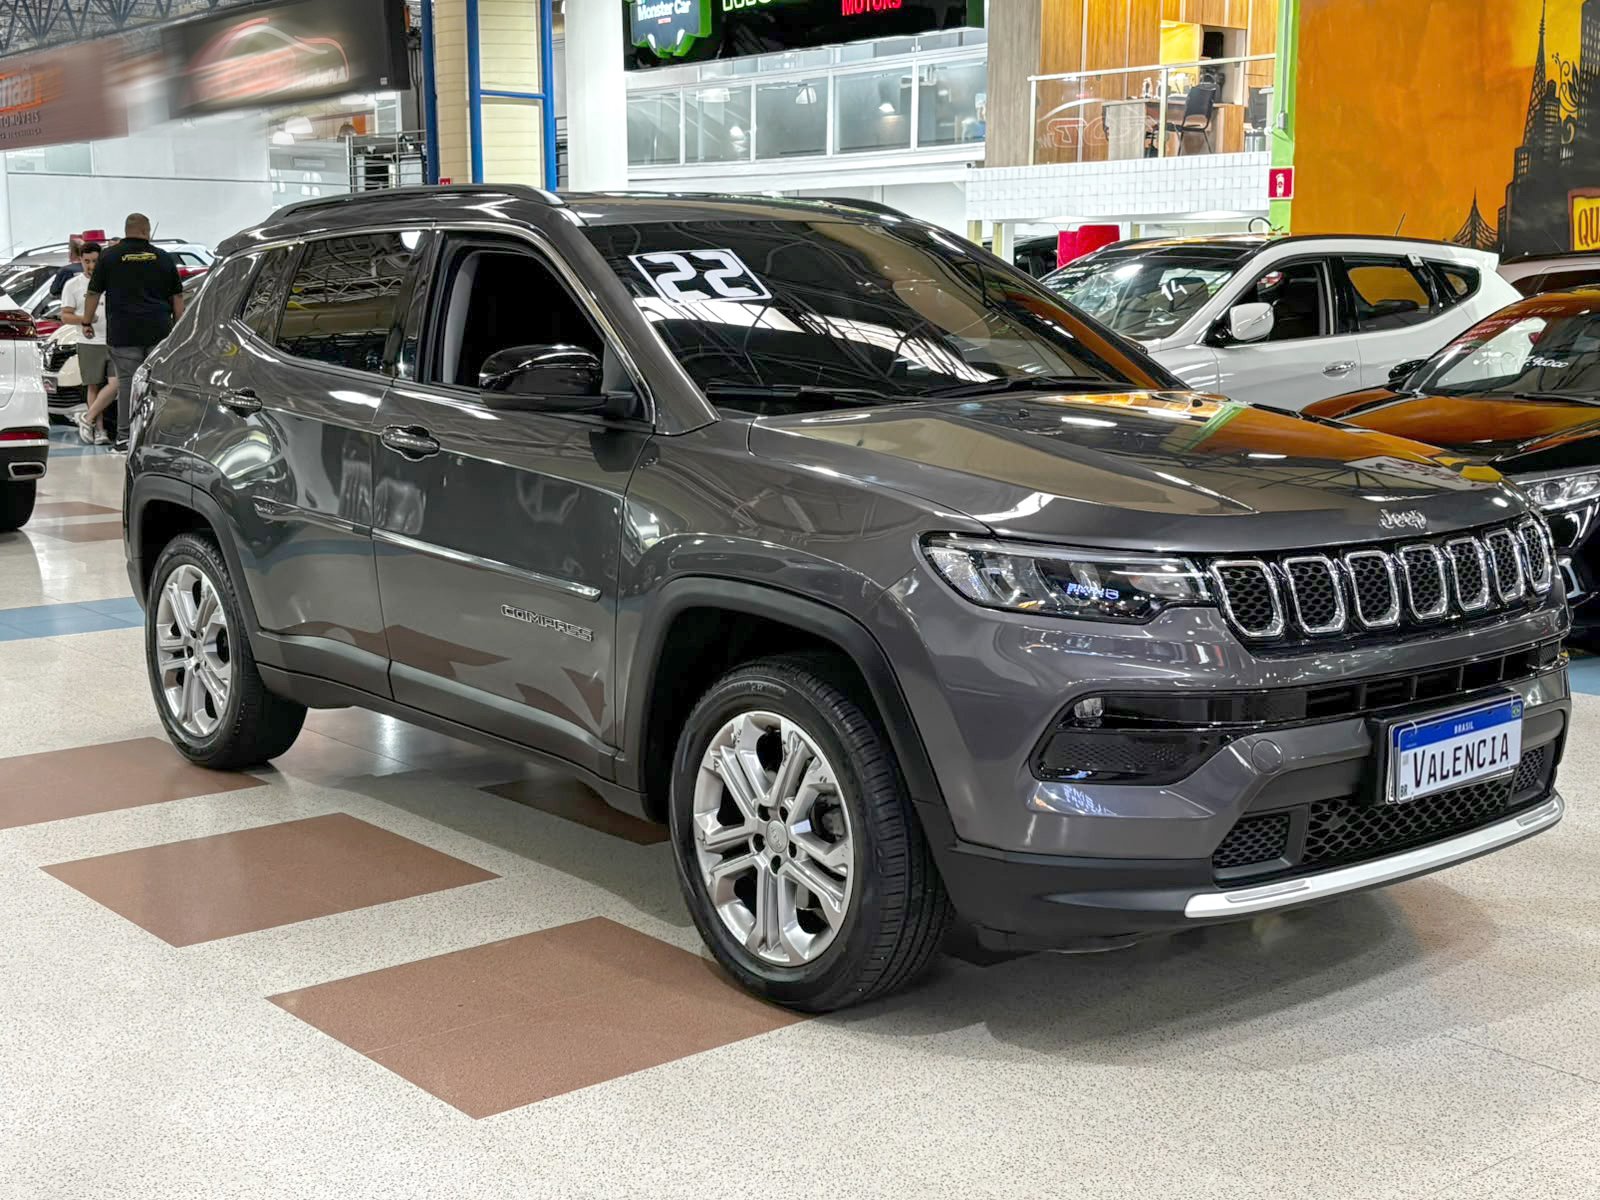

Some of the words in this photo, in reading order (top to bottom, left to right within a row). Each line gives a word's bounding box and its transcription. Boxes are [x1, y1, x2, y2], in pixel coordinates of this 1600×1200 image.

[637, 2, 674, 21] Monster
[674, 0, 691, 14] Car
[642, 251, 759, 300] 22
[1161, 280, 1188, 301] 14
[1380, 508, 1426, 529] Jeep
[501, 604, 593, 642] COMPASS
[1454, 721, 1474, 734] BRASIL
